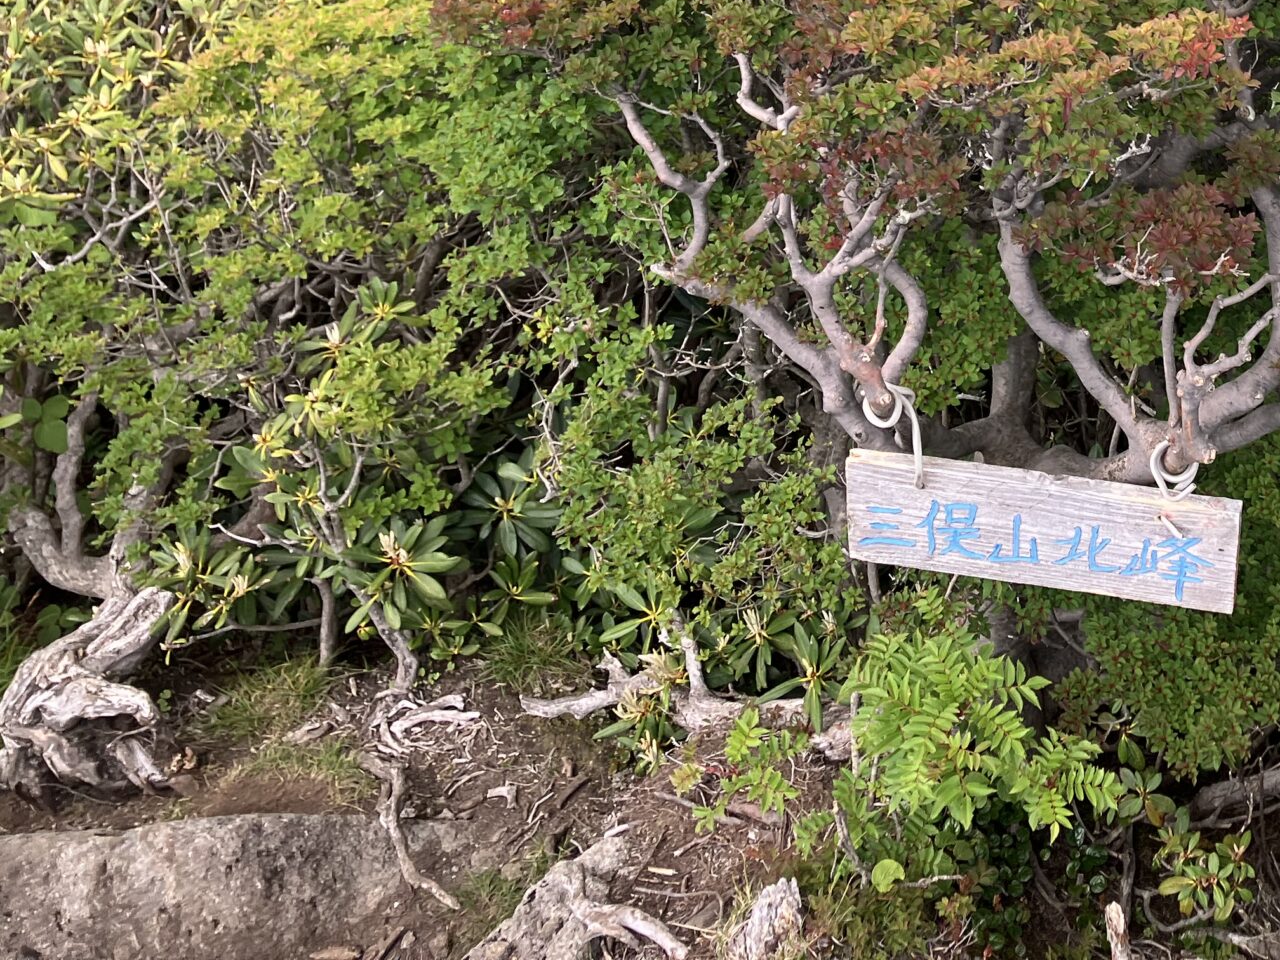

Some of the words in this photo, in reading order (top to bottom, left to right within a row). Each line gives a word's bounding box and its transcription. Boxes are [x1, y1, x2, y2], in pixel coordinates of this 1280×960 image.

[859, 499, 1214, 601] 三俣山北峰
